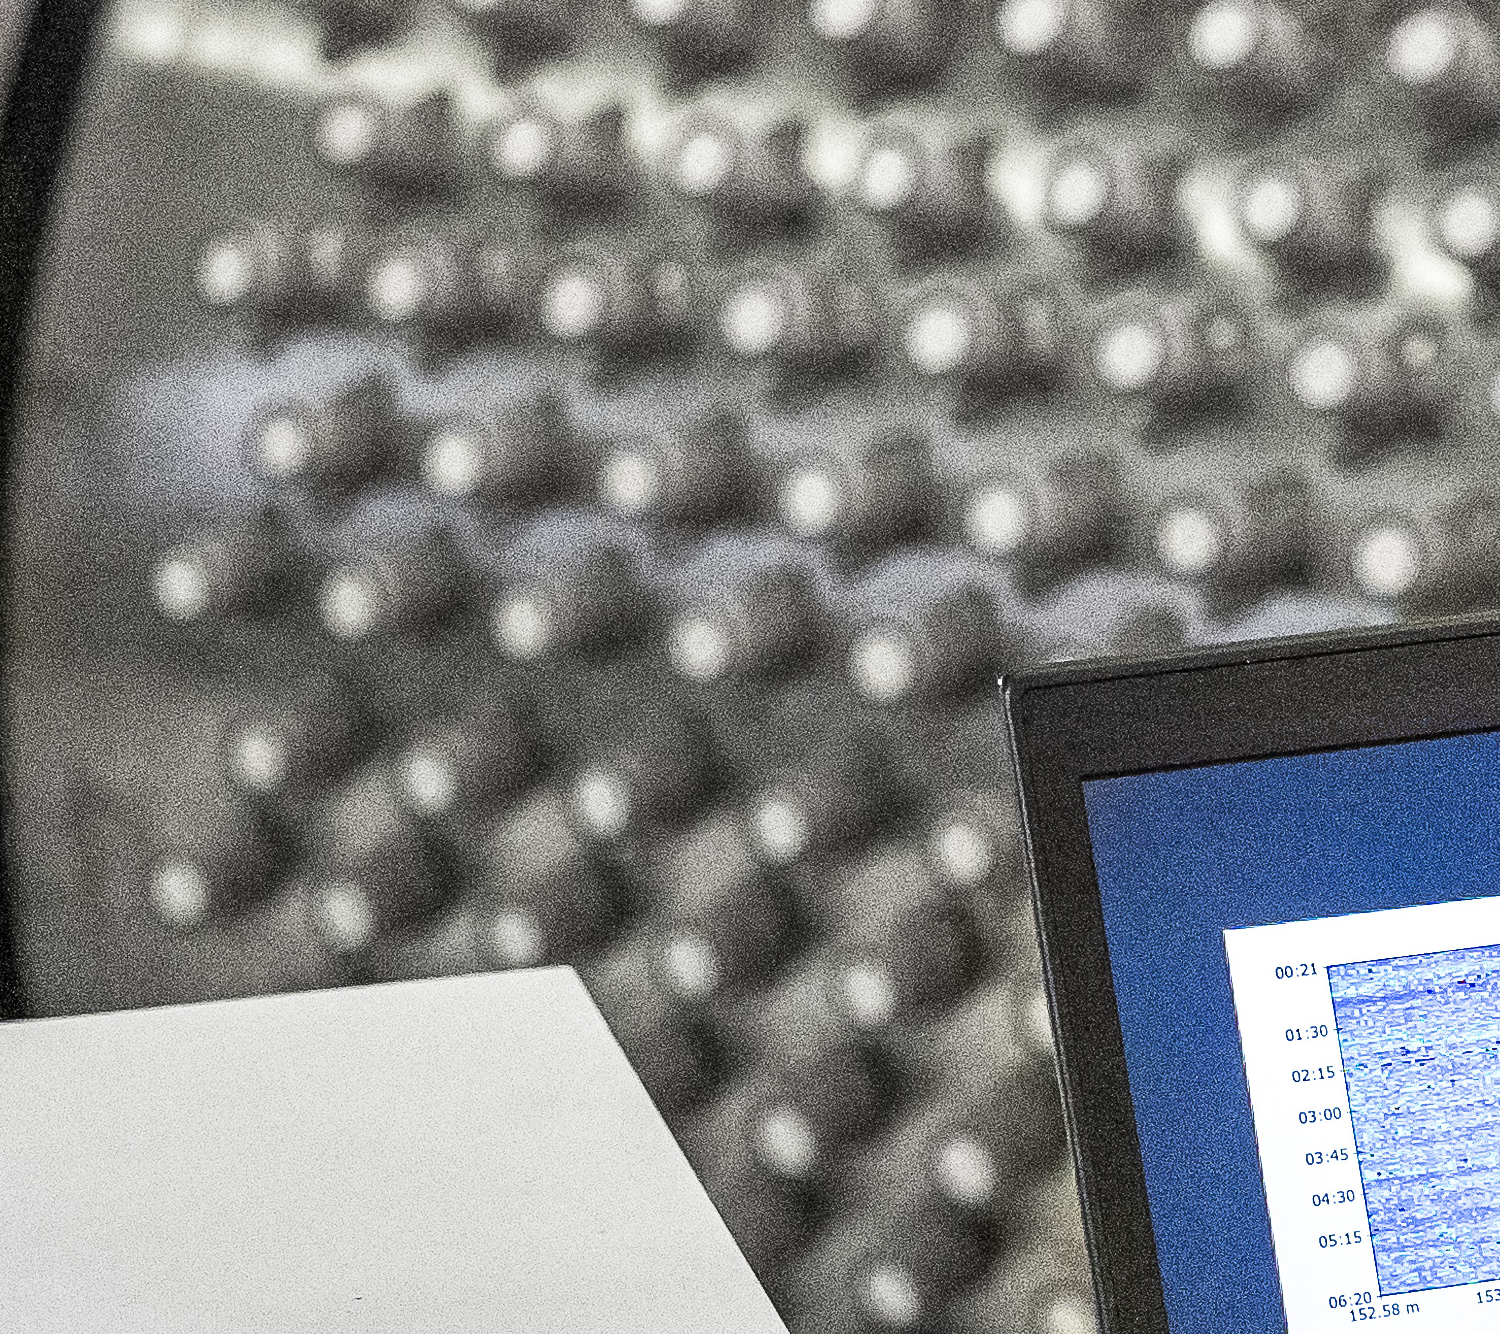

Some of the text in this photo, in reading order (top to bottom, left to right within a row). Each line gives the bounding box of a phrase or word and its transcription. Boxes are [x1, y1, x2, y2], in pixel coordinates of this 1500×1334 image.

[1276, 963, 1316, 979] 00:21
[1286, 1025, 1327, 1041] 01:30
[1292, 1066, 1334, 1082] 02:15
[1299, 1108, 1341, 1124] 03:00
[1306, 1149, 1348, 1165] 03:45
[1313, 1190, 1354, 1206] 04:30
[1319, 1231, 1361, 1248] 05:15
[1329, 1292, 1372, 1309] 06:20
[1350, 1303, 1419, 1322] 152.58 m
